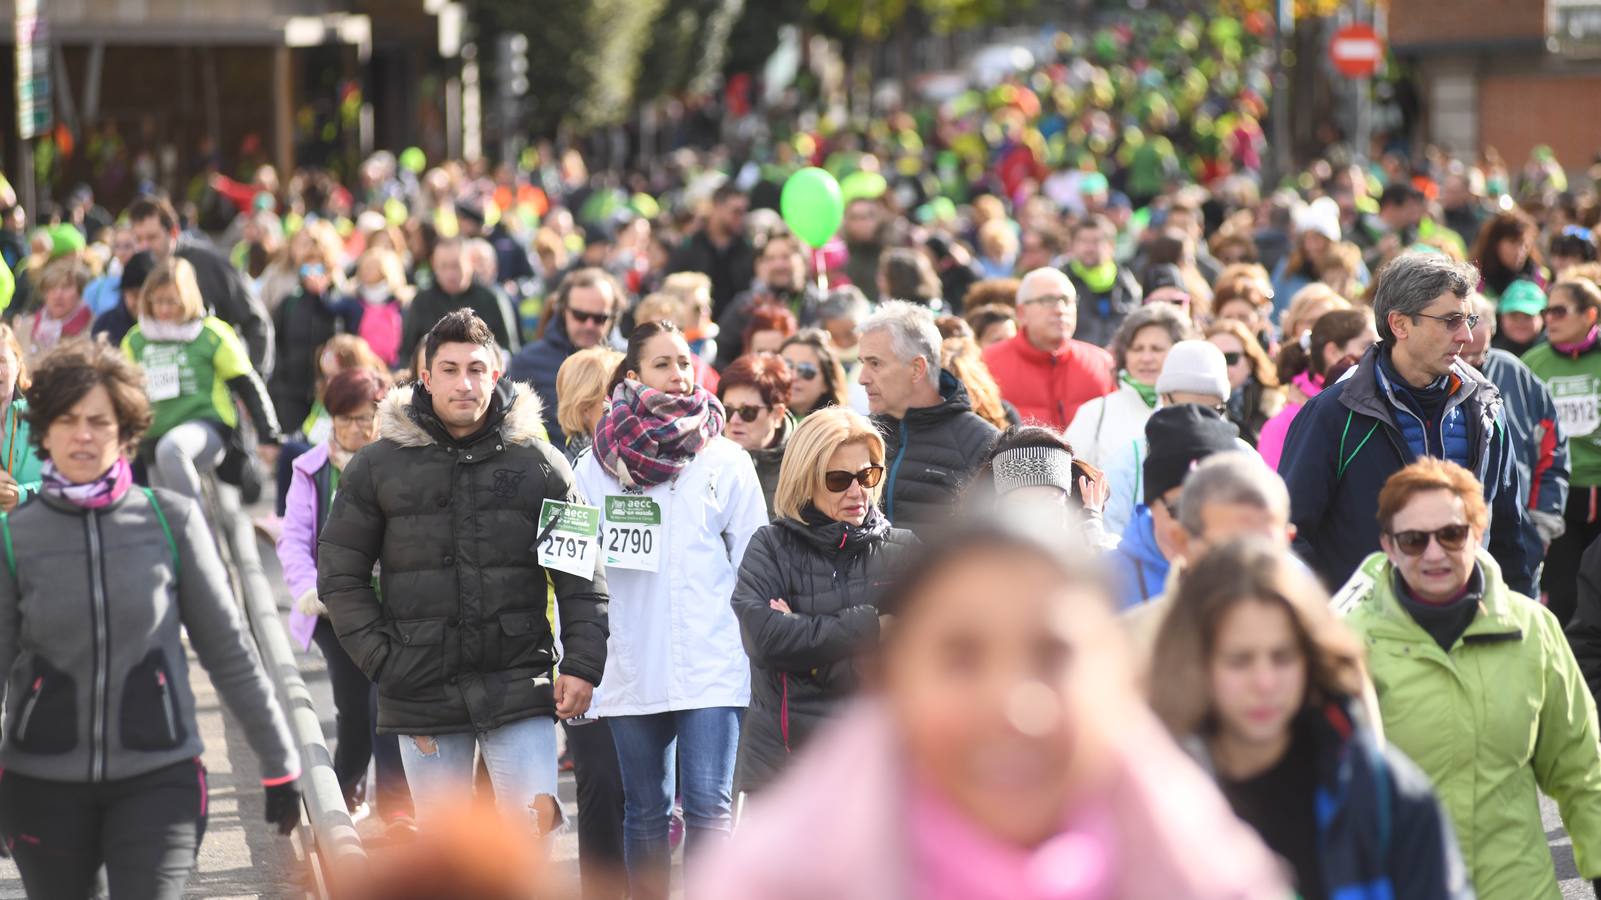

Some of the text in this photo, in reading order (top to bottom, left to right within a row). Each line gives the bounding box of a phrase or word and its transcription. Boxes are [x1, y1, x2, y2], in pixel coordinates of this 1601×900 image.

[627, 500, 652, 508] aecc
[564, 508, 589, 519] aecc
[544, 534, 588, 561] 2797
[609, 528, 652, 554] 2790
